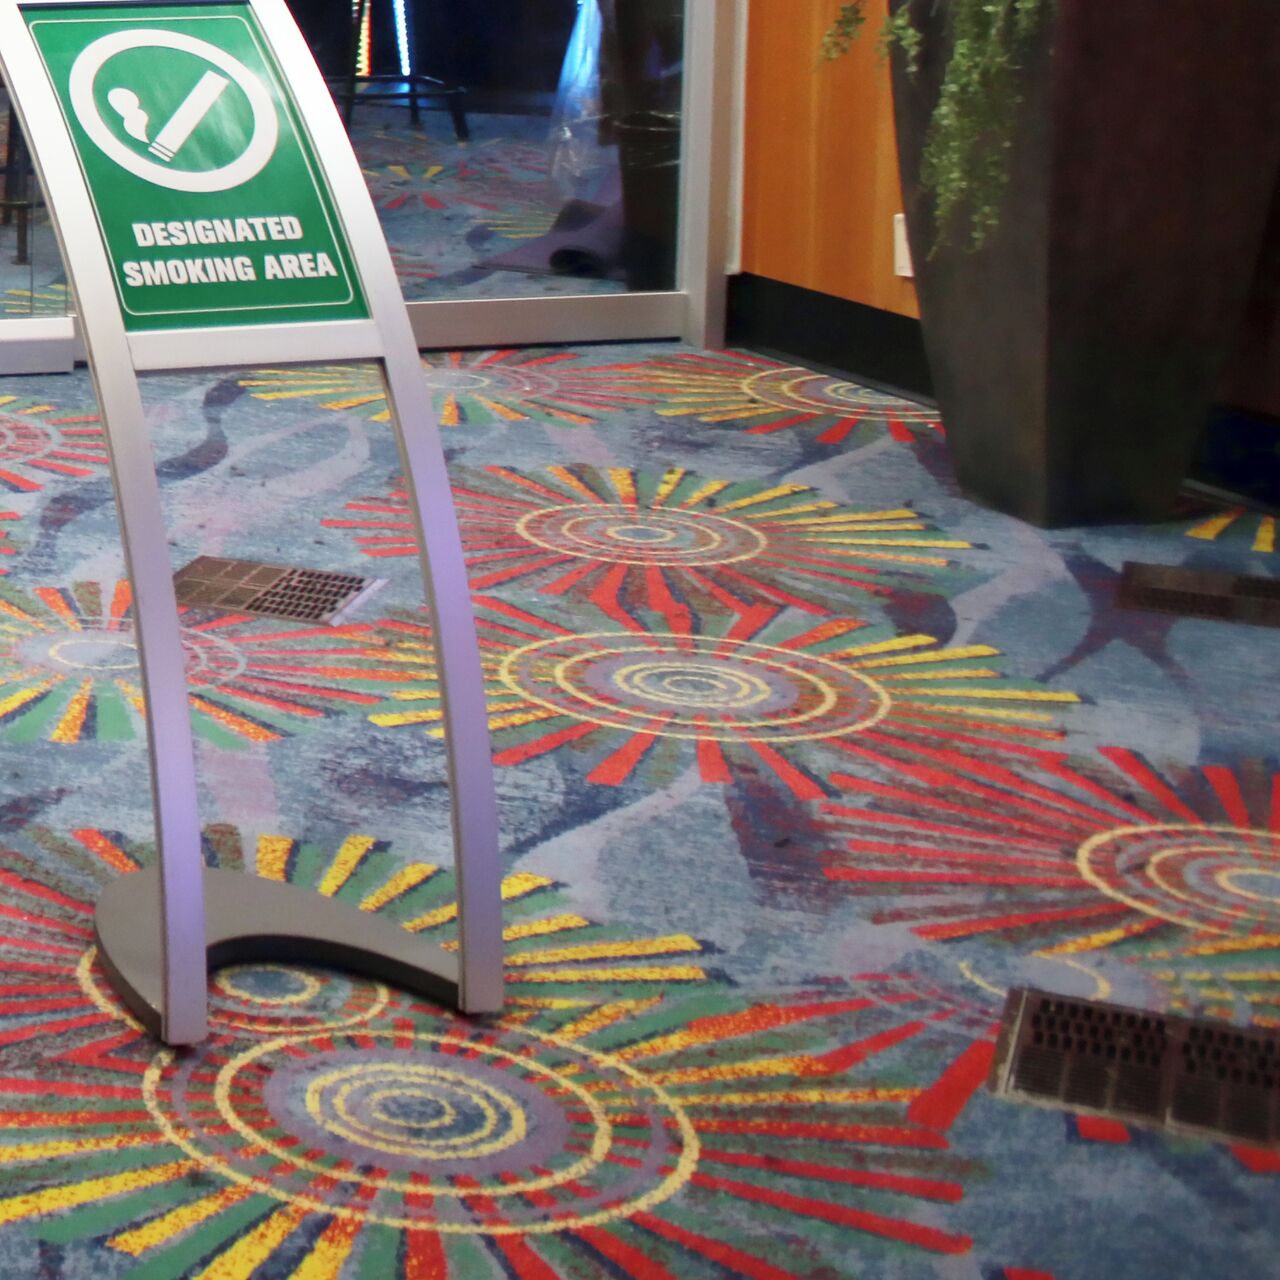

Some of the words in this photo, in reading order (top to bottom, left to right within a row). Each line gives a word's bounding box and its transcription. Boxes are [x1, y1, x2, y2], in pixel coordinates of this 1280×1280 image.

[131, 216, 303, 247] DESIGNATED
[122, 256, 257, 287] SMOKING
[264, 252, 338, 281] AREA
